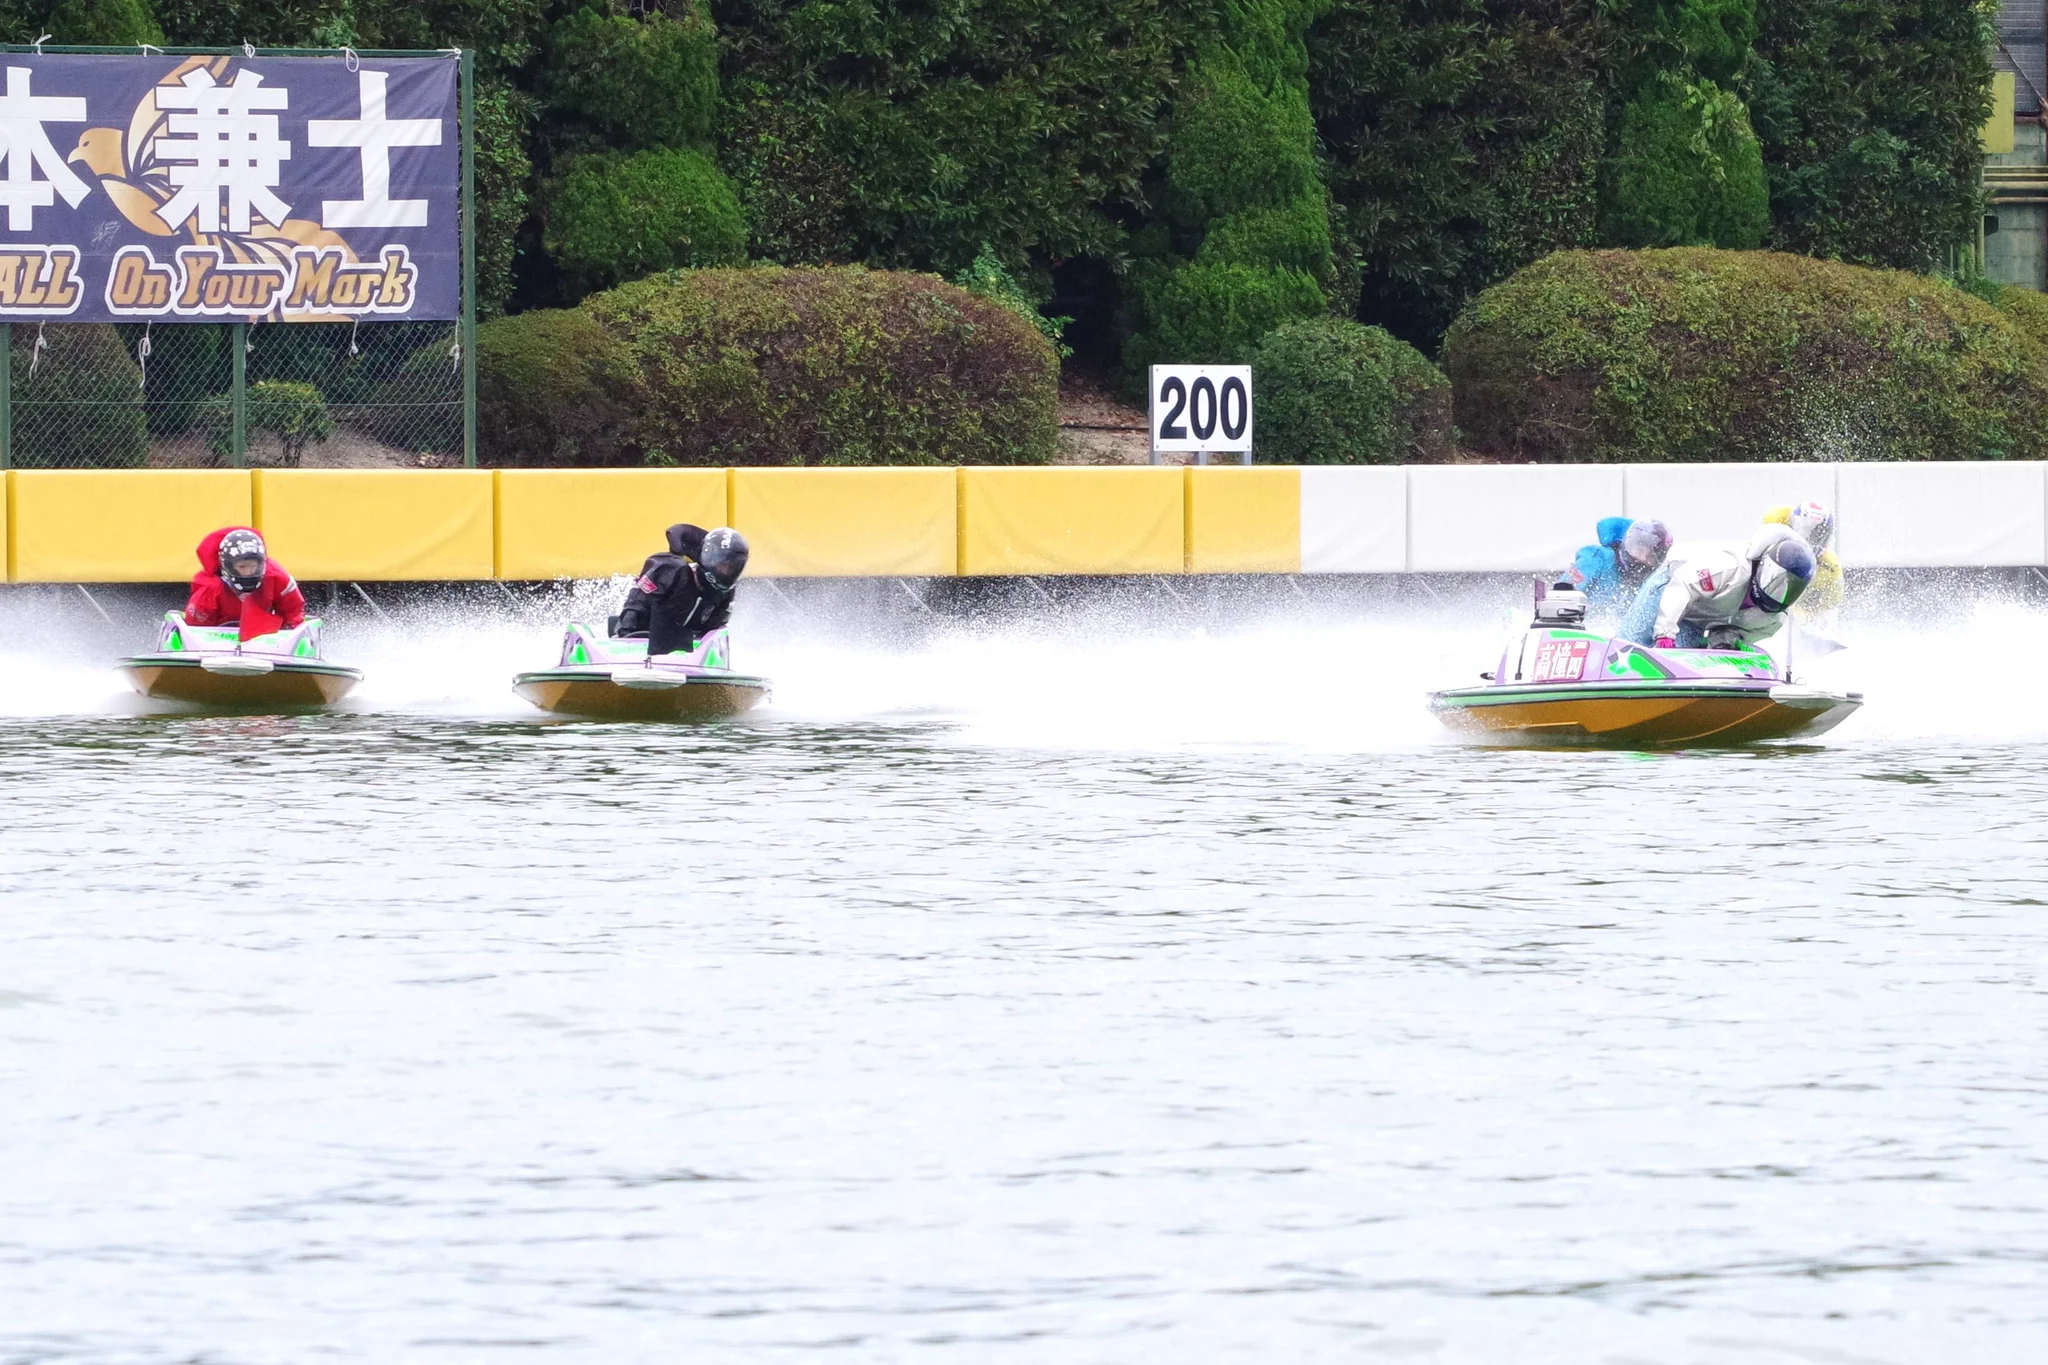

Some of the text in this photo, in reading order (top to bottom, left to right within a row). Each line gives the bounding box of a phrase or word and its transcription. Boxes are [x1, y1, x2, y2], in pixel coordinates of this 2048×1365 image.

[108, 249, 175, 310] On
[177, 249, 286, 310] Your
[284, 248, 414, 310] Mark
[1159, 376, 1248, 440] 200
